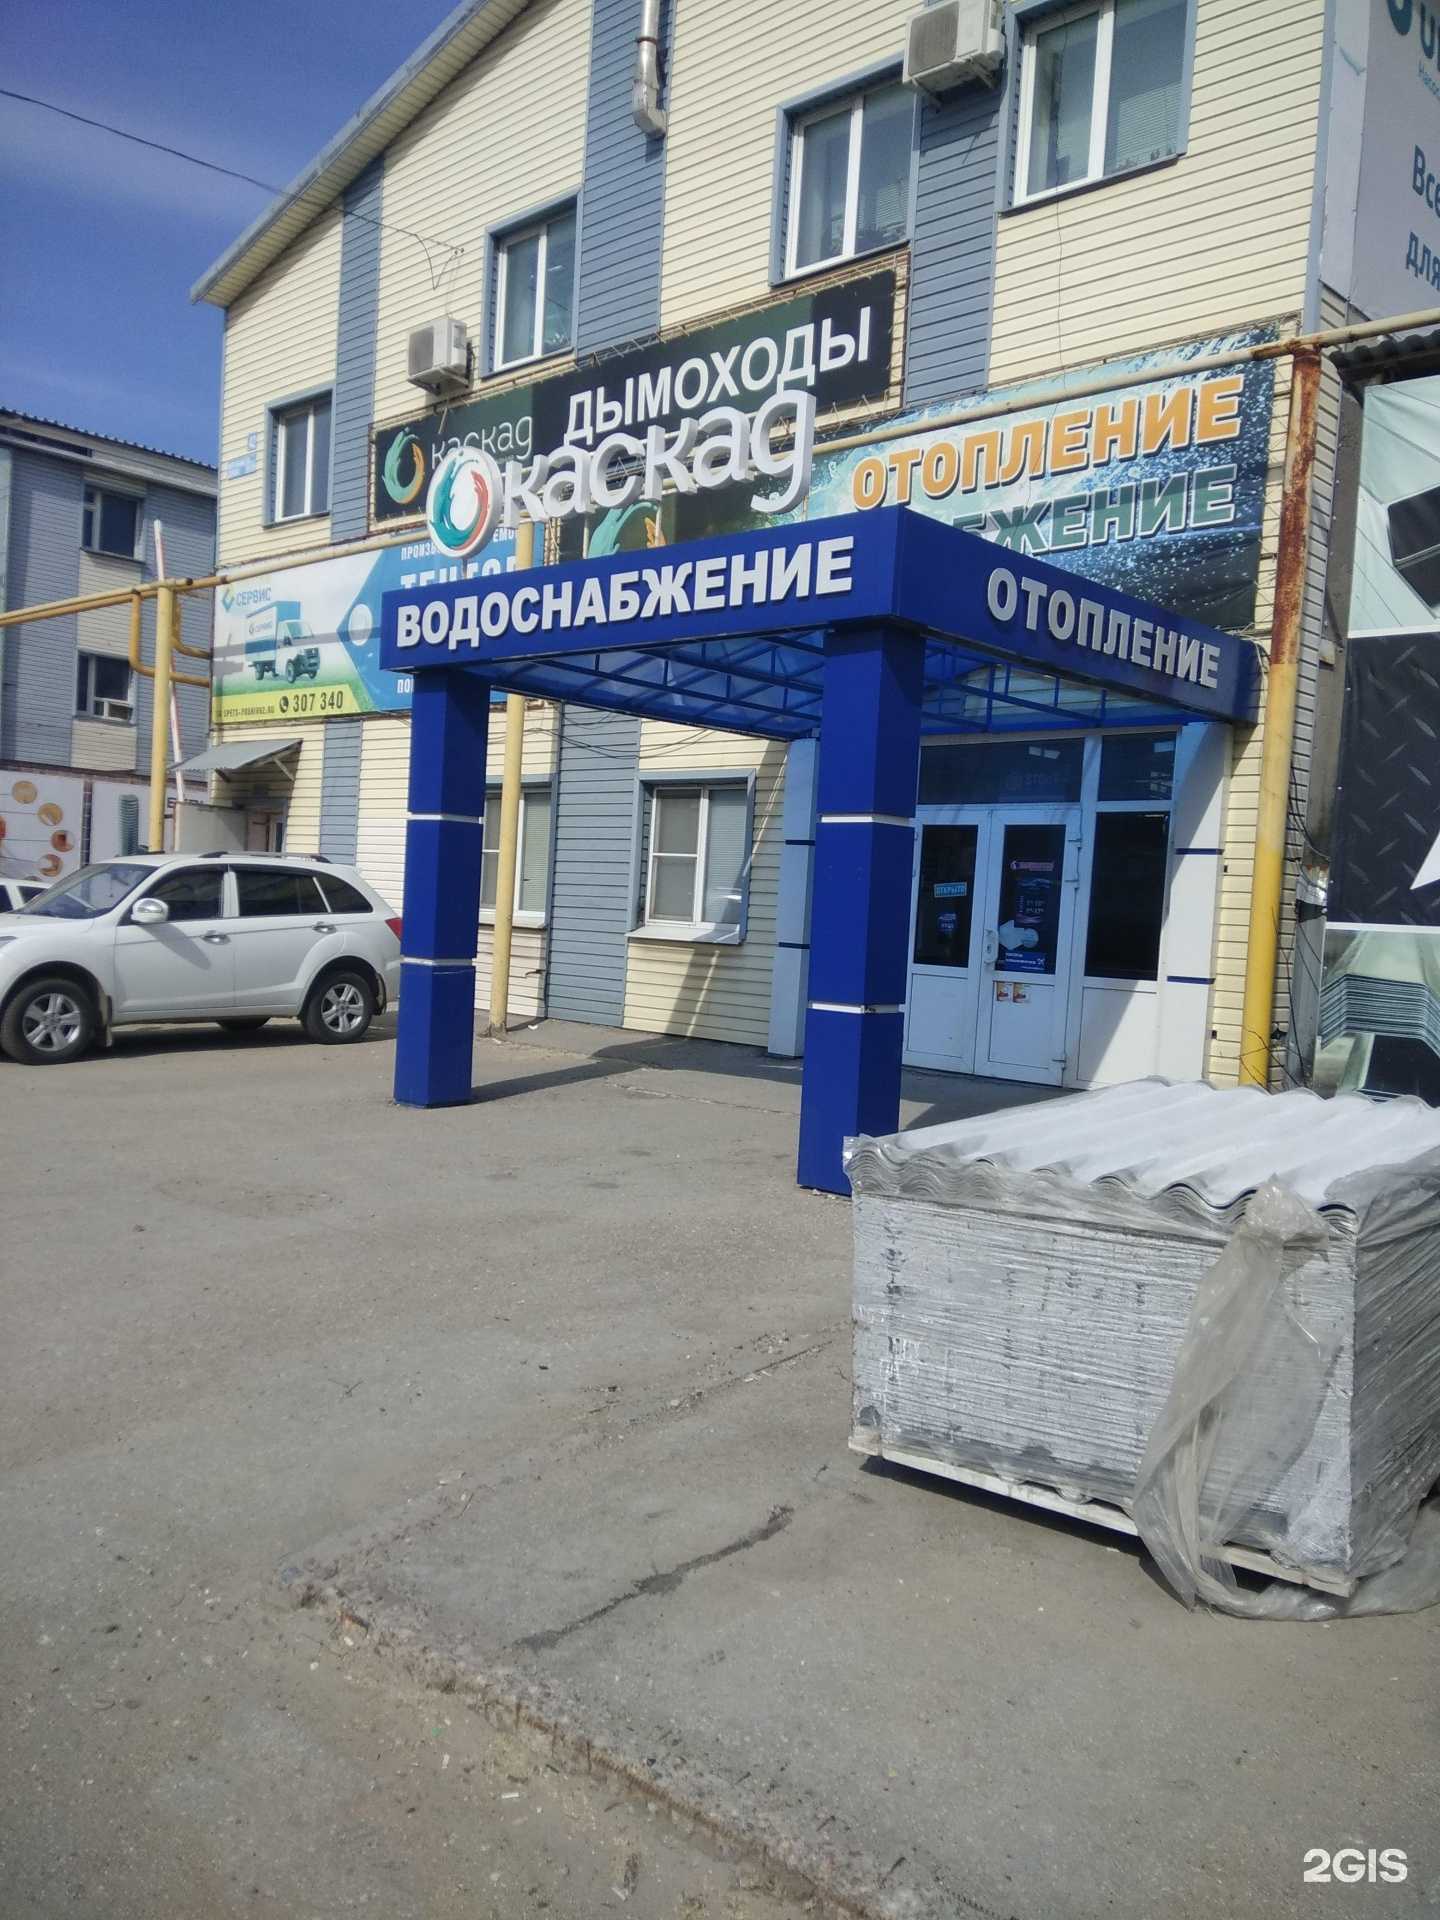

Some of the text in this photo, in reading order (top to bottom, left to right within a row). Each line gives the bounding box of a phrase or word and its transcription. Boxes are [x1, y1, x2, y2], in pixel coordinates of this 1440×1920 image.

[563, 306, 871, 446] ДЫМОХОДЫ
[504, 389, 817, 527] каскад
[852, 374, 1244, 512] ОТОПЛЕНИЕ
[236, 586, 272, 607] СЕРВИС
[397, 535, 854, 650] ВОДОСНАБЖЕНИЕ
[987, 567, 1221, 689] ОТОПЛЕНИЕ
[292, 693, 315, 713] 307
[320, 690, 344, 710] 340
